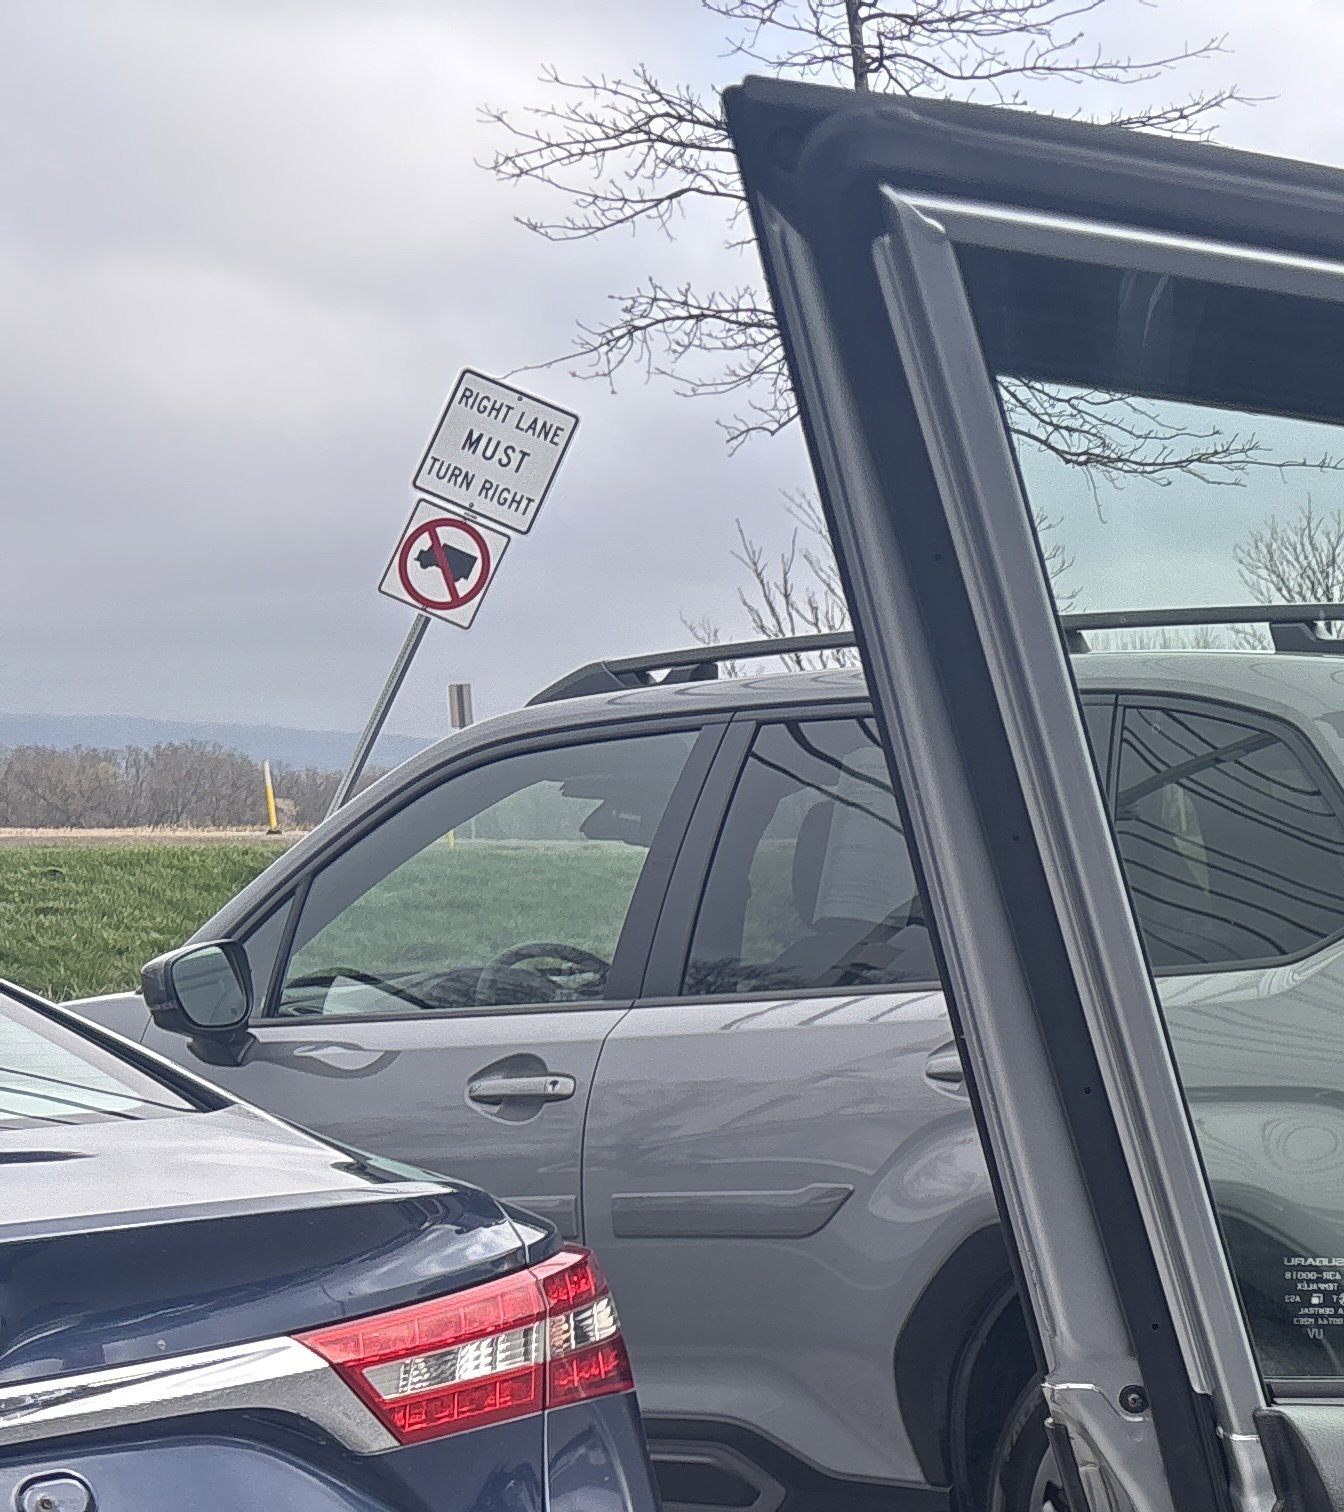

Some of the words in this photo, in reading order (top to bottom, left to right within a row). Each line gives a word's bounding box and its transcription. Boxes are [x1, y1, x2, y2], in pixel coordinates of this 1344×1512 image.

[457, 386, 514, 424] RIGHT
[514, 411, 565, 446] LANE
[460, 428, 531, 474] MUST
[426, 455, 476, 491] TURN
[477, 478, 536, 516] RIGHT
